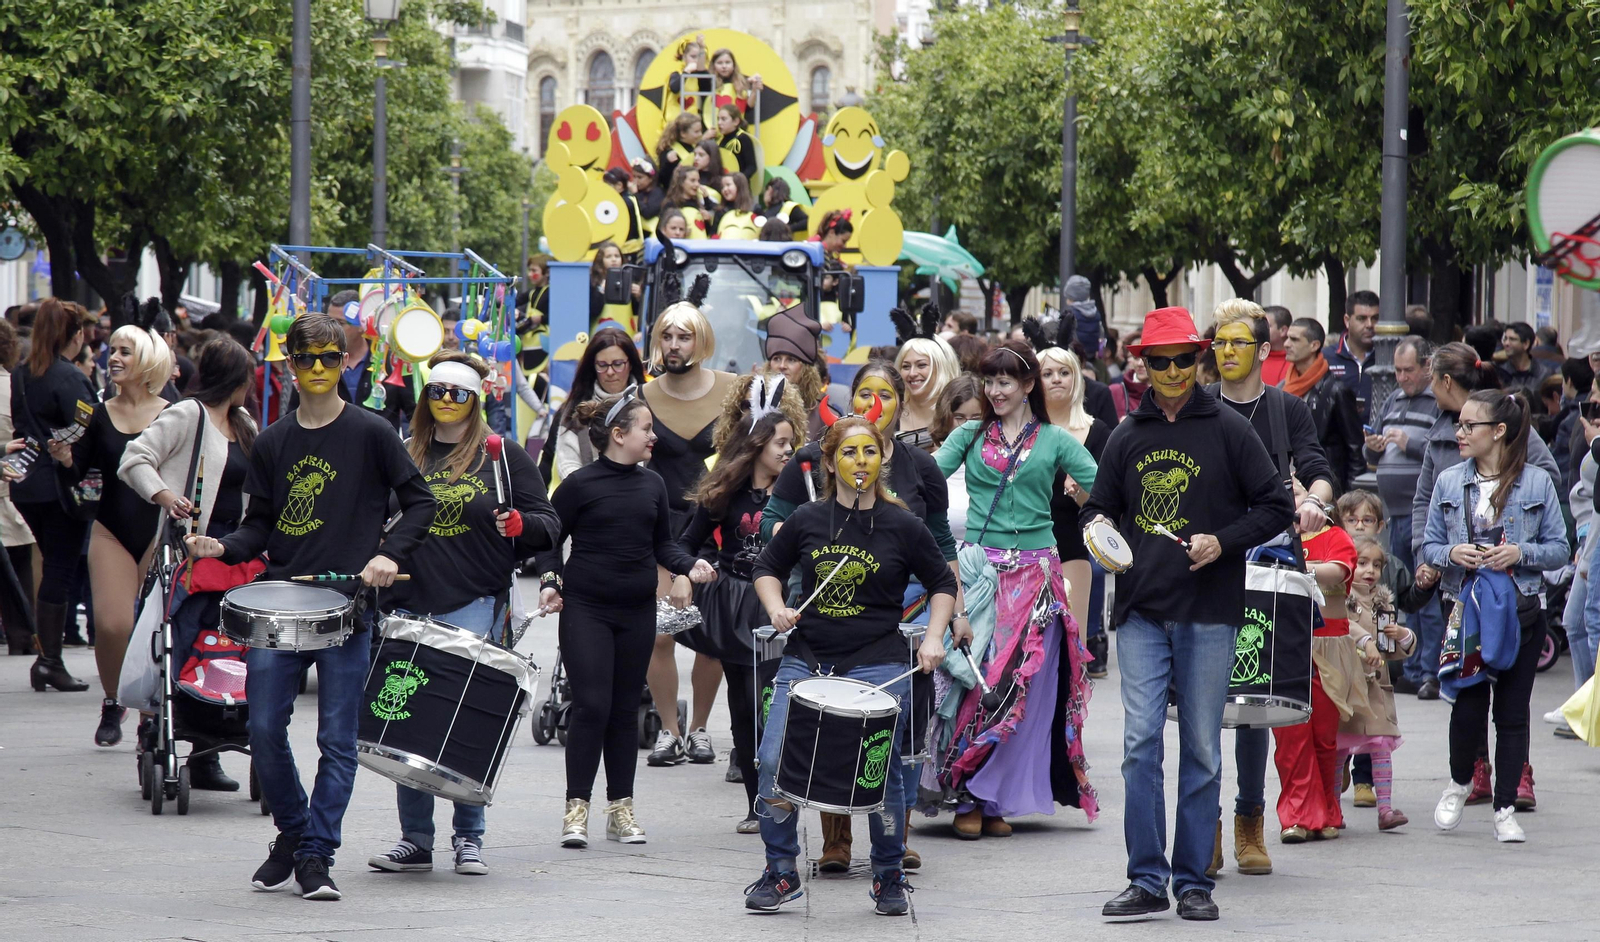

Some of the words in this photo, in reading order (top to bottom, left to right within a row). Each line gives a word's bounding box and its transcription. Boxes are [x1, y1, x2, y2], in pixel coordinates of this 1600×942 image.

[1135, 448, 1201, 478] BATUKADA
[423, 470, 489, 495] BATKADA
[276, 518, 325, 537] AIPIRIÑA
[428, 523, 472, 537] PIRIÑA
[810, 544, 881, 574] BATUKADA
